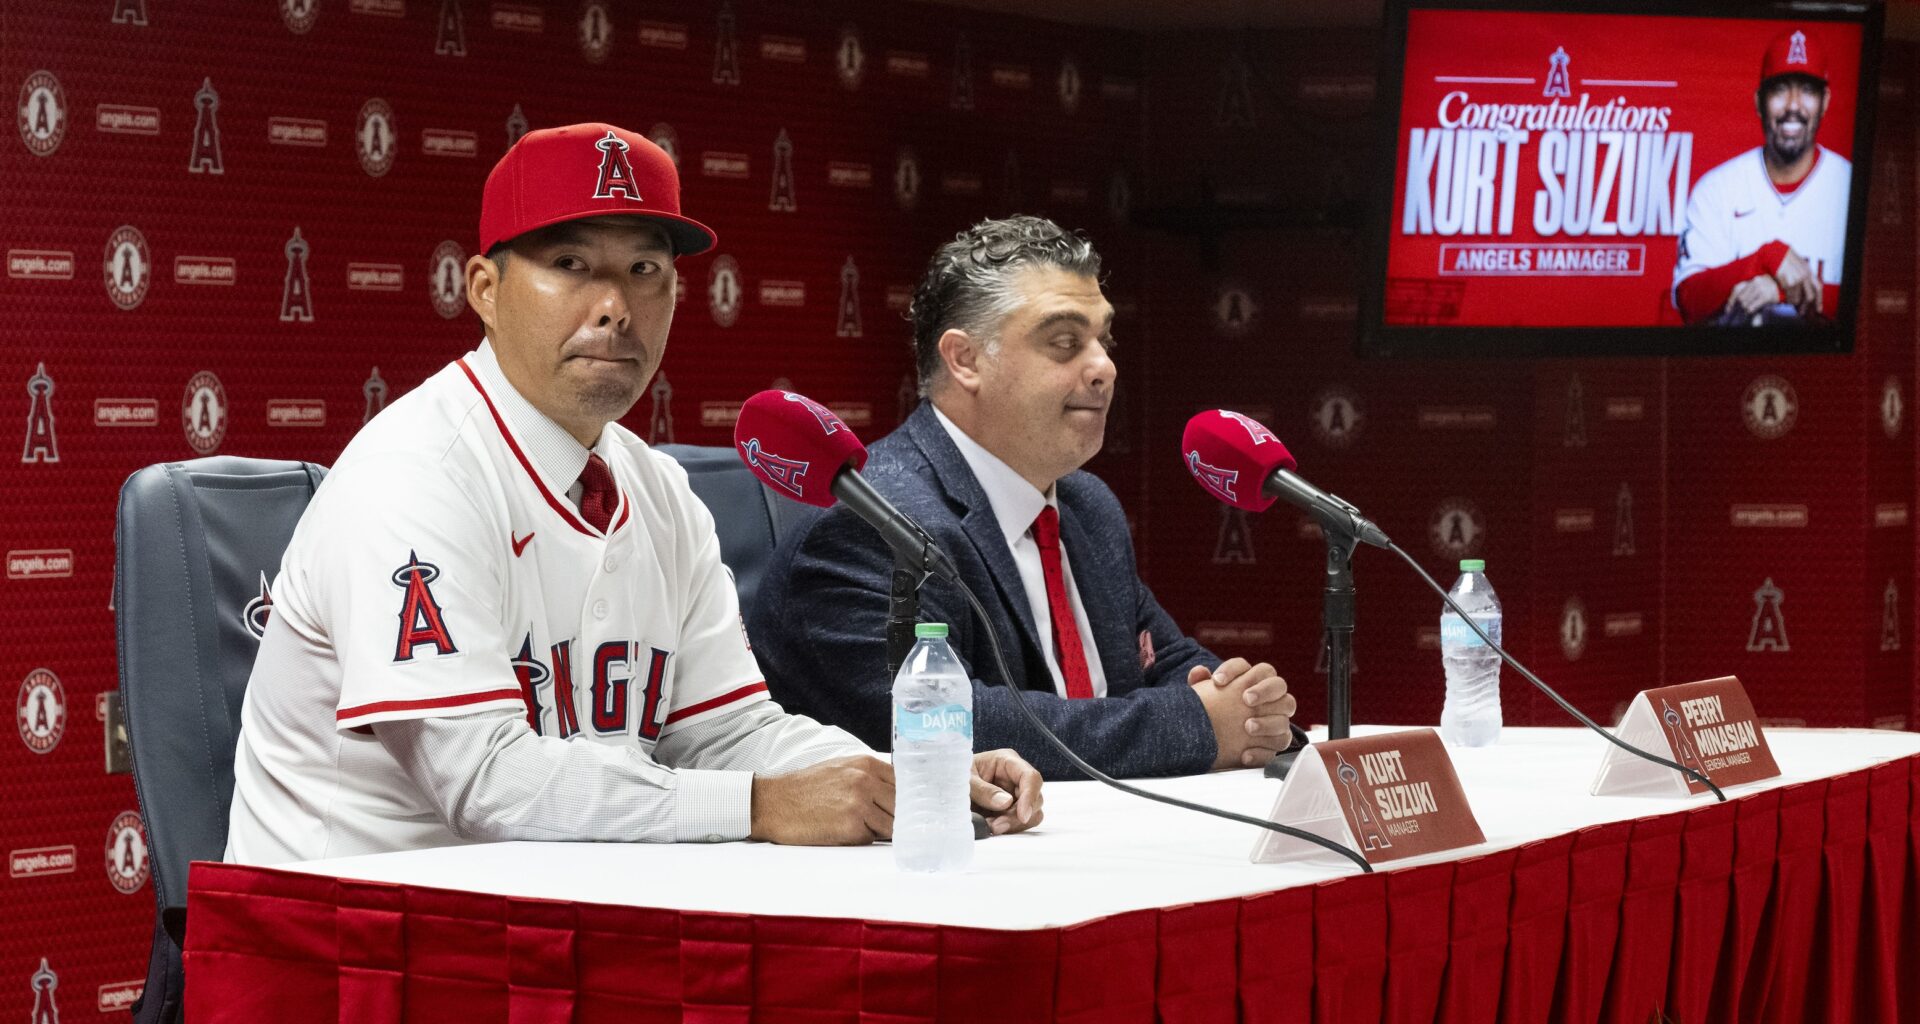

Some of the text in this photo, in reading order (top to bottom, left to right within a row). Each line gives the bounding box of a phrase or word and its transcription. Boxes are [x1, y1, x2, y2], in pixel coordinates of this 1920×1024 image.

[1543, 46, 1571, 98] A
[1438, 91, 1671, 139] Congratulations
[592, 130, 644, 201] A
[1402, 128, 1693, 237] KURT SUZUKI
[10, 257, 71, 274] angels.com
[1455, 249, 1630, 271] ANGELS MANAGER
[22, 361, 60, 463] A
[780, 390, 852, 436] A
[741, 438, 810, 498] A
[1185, 450, 1239, 502] A
[9, 557, 70, 575] angels.com
[393, 548, 460, 664] A
[921, 708, 967, 731] DASANI
[1680, 695, 1726, 728] PERRY
[1693, 720, 1760, 758] MINASIAN
[1359, 750, 1408, 786] KURT
[1703, 752, 1753, 772] GENERAL MANAGER
[1336, 750, 1393, 851] A
[1374, 781, 1439, 821] SUZUKI
[1385, 819, 1421, 838] MANAGER
[12, 853, 73, 873] angels.com
